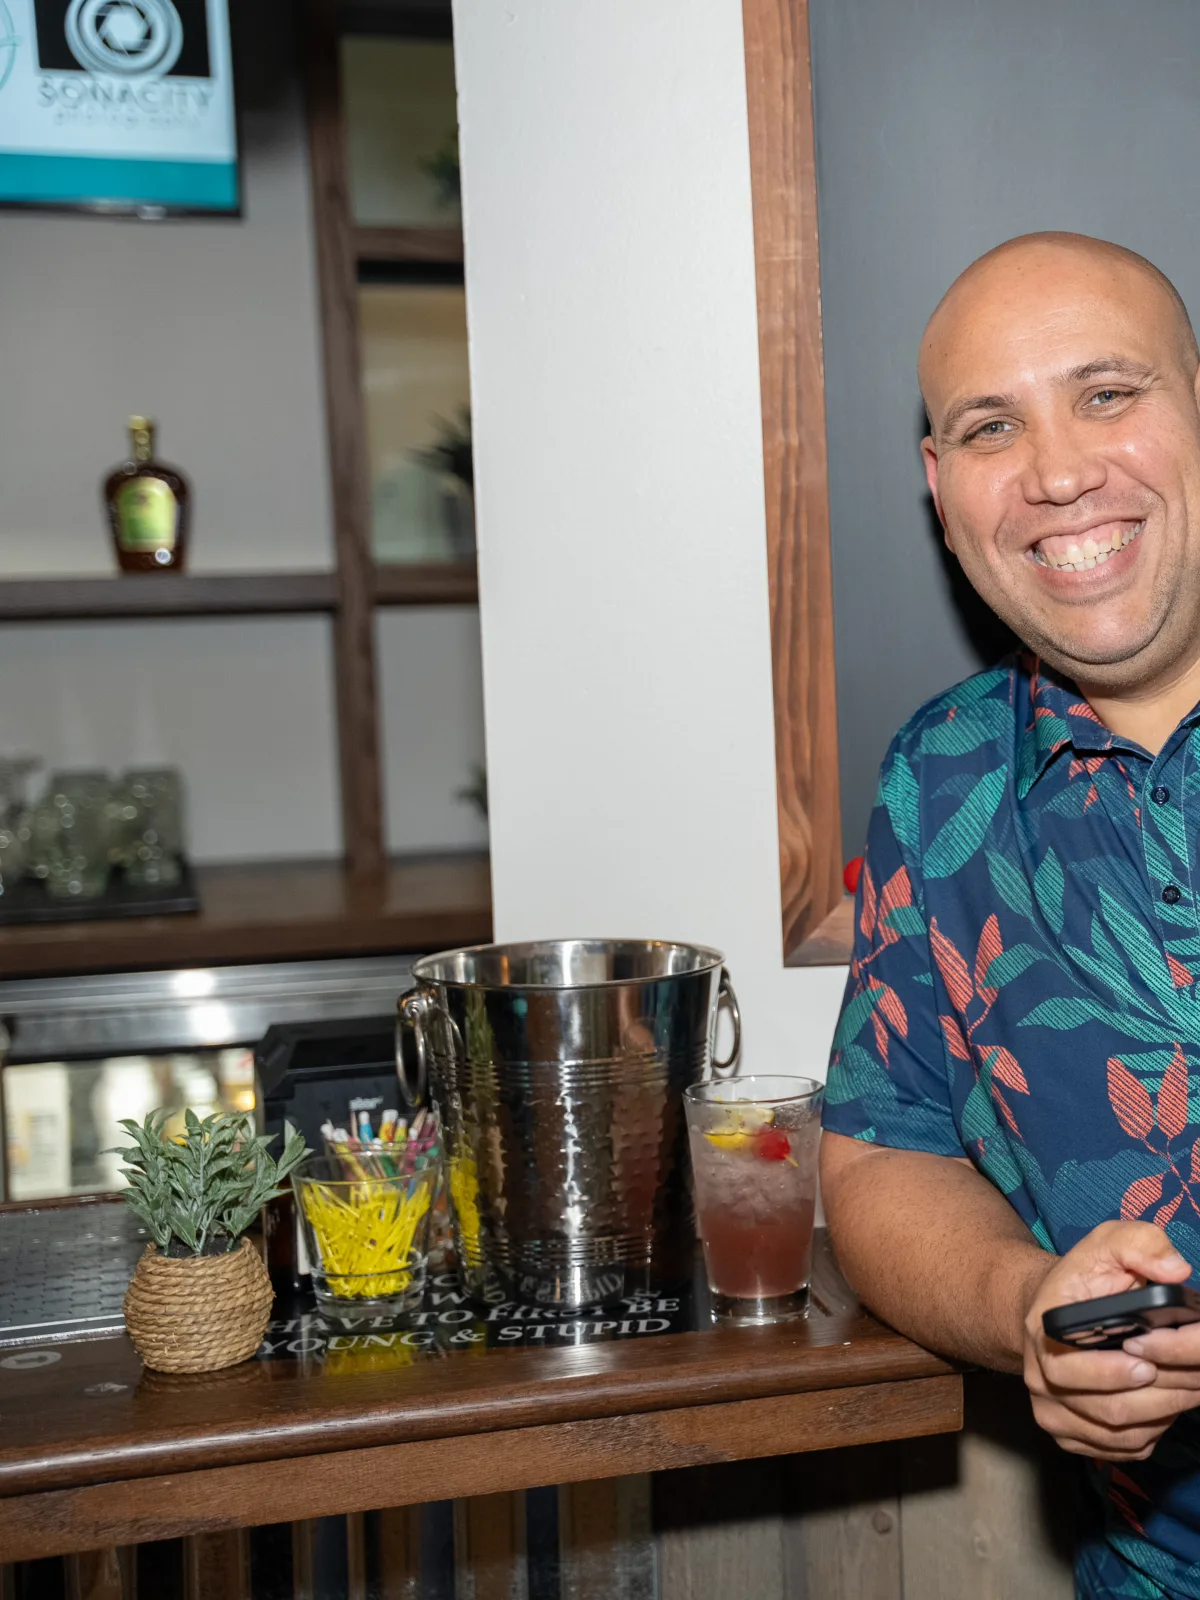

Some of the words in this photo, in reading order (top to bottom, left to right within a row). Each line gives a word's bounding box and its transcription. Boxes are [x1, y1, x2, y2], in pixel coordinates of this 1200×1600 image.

[268, 1313, 398, 1334] HAVE
[410, 1310, 474, 1326] TO
[628, 1297, 681, 1314] BE
[259, 1330, 435, 1355] YOUNG
[449, 1328, 486, 1343] &
[497, 1318, 671, 1341] STUPID
